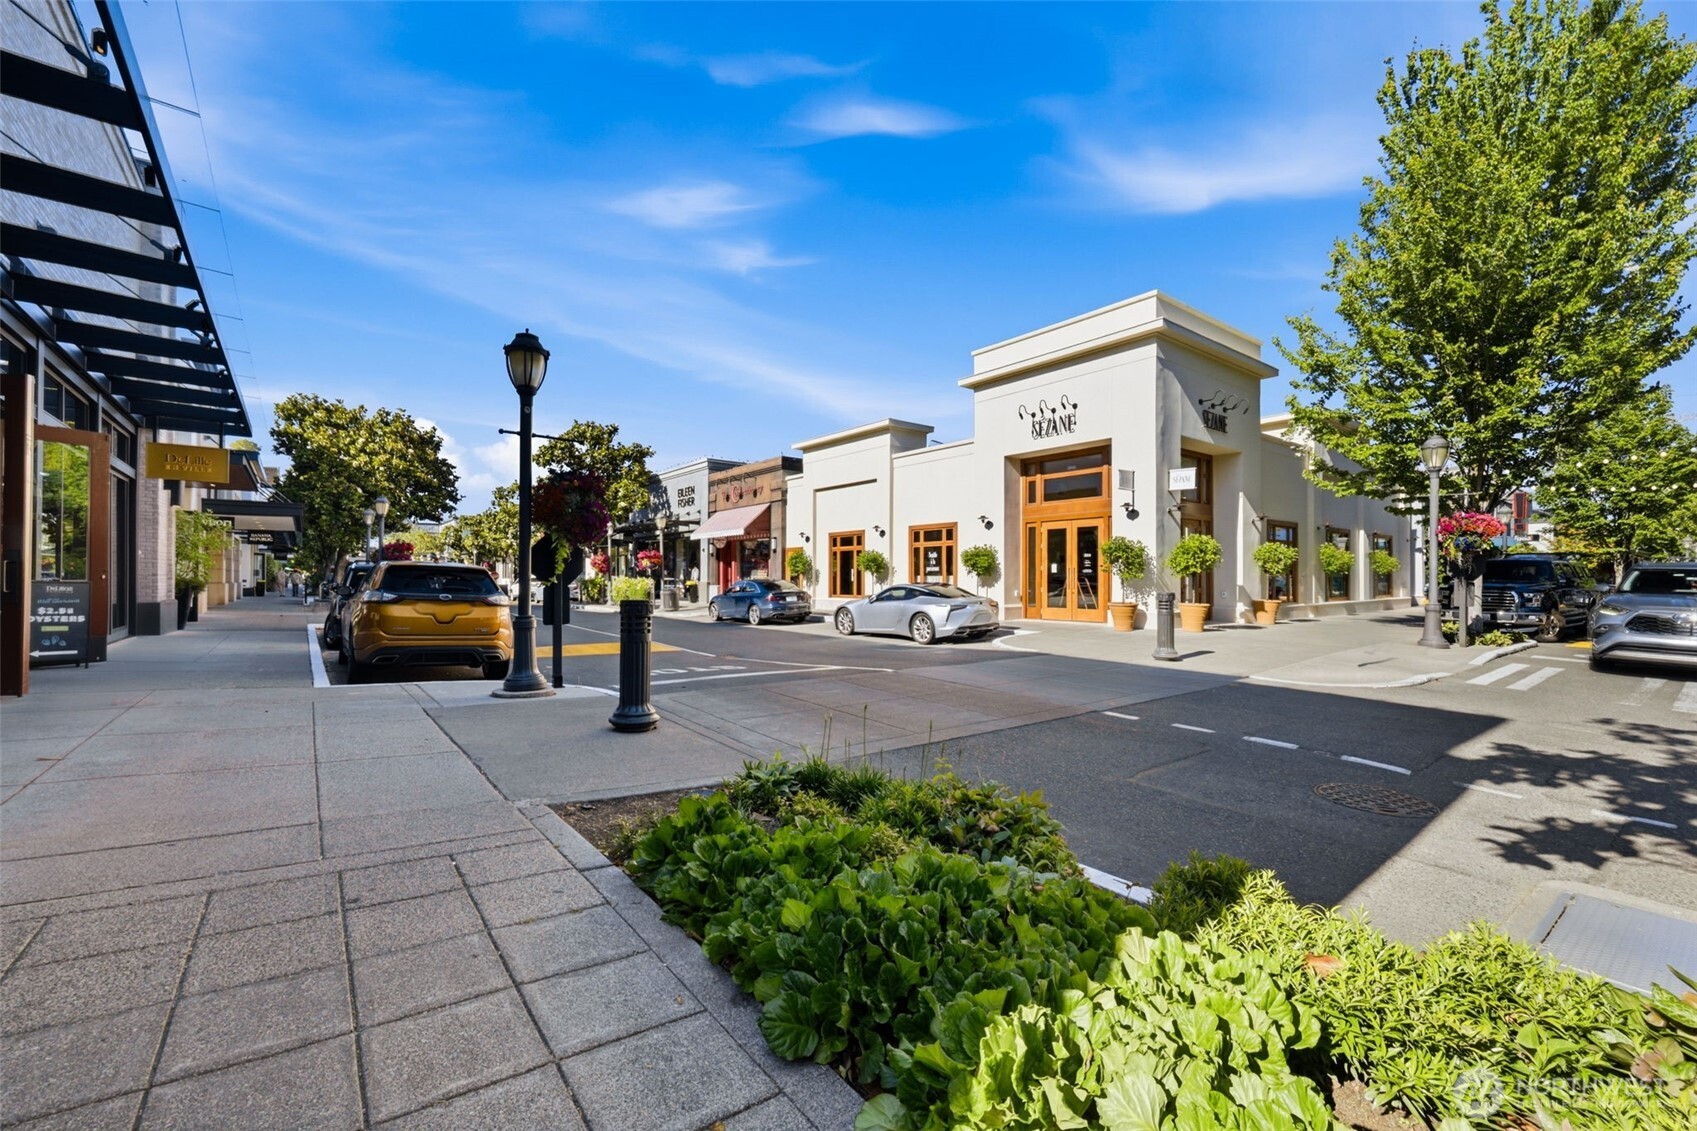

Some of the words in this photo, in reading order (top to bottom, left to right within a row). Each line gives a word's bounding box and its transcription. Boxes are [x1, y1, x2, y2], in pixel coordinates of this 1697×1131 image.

[1031, 412, 1076, 439] SÉZANE
[677, 485, 696, 498] EILEEN
[677, 496, 696, 508] FISHER
